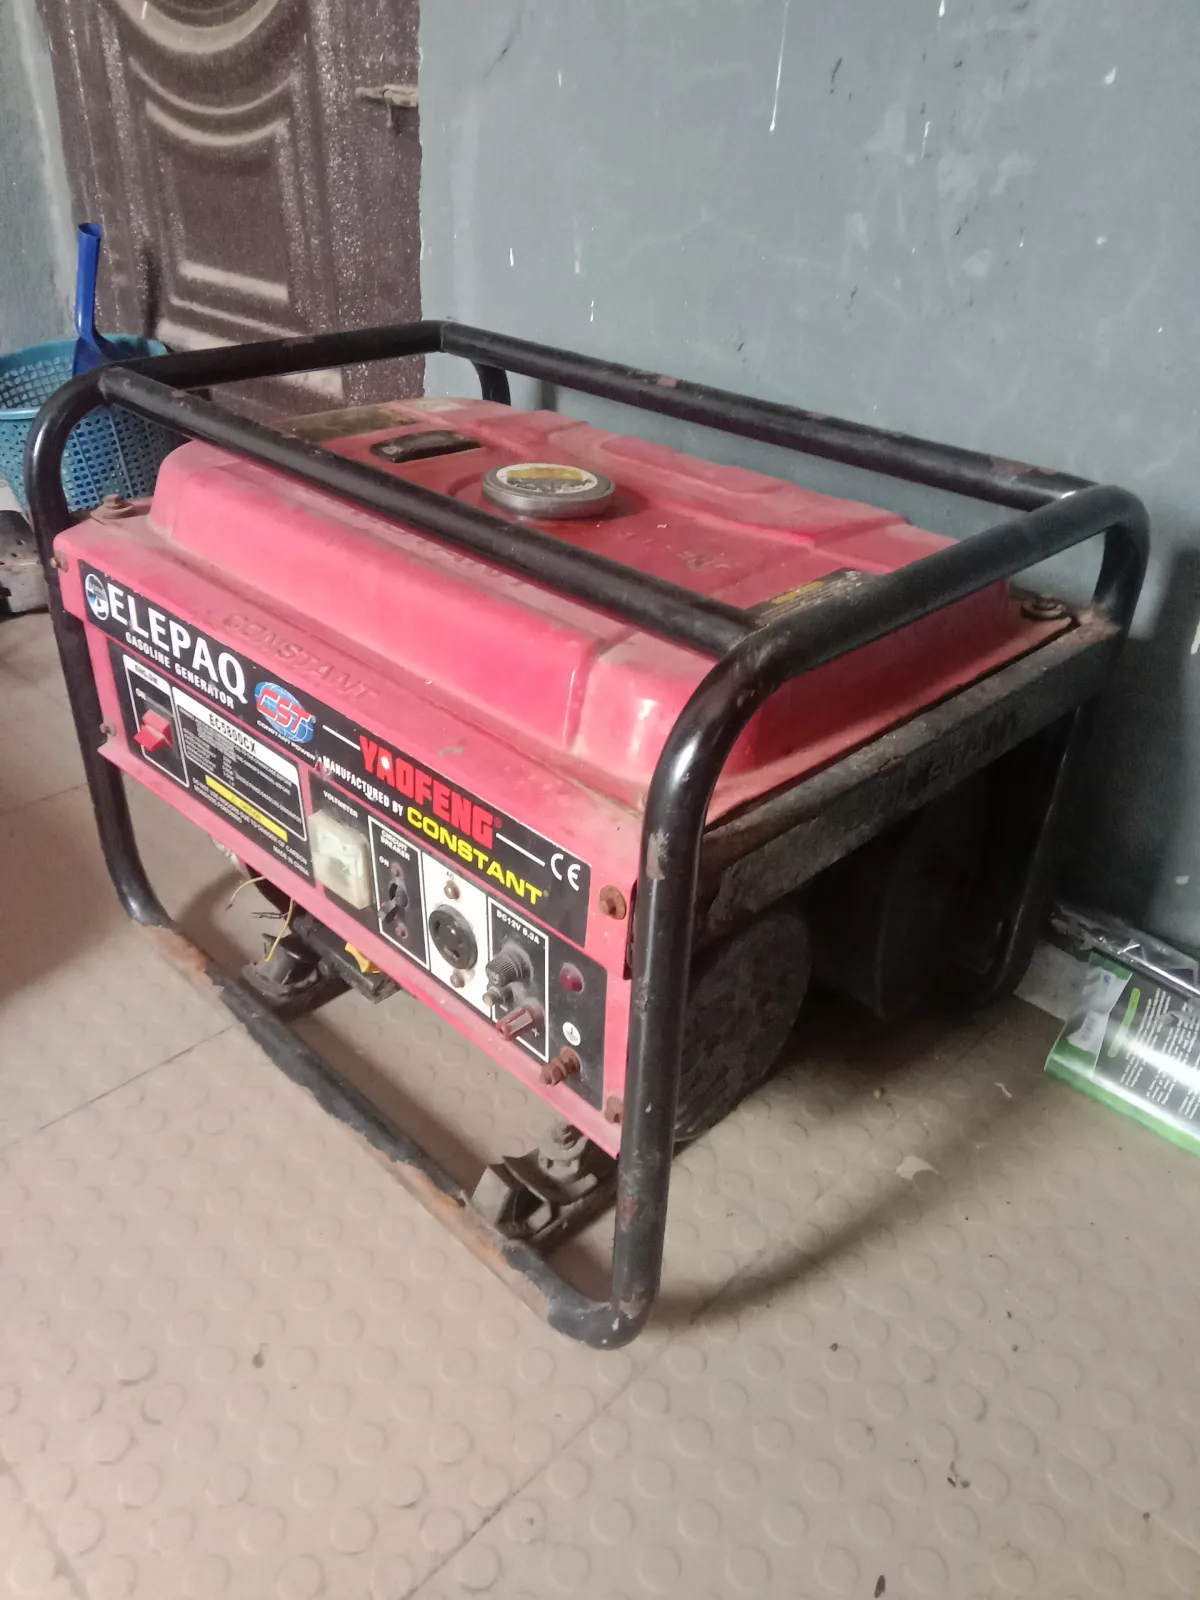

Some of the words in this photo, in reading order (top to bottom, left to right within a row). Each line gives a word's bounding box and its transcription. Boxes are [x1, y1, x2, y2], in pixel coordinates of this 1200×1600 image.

[107, 582, 249, 705] ELEPAQ
[125, 631, 171, 669] GASOLINE
[174, 663, 235, 710] GENERATOR
[256, 687, 312, 734] CST
[323, 789, 358, 819] VOLTMETER
[359, 734, 493, 850] YAOFENG
[322, 755, 390, 808] MANUFACTURED
[392, 800, 404, 817] BY
[407, 805, 544, 905] CONSTANT
[379, 855, 390, 868] ON
[495, 908, 521, 932] DC12V
